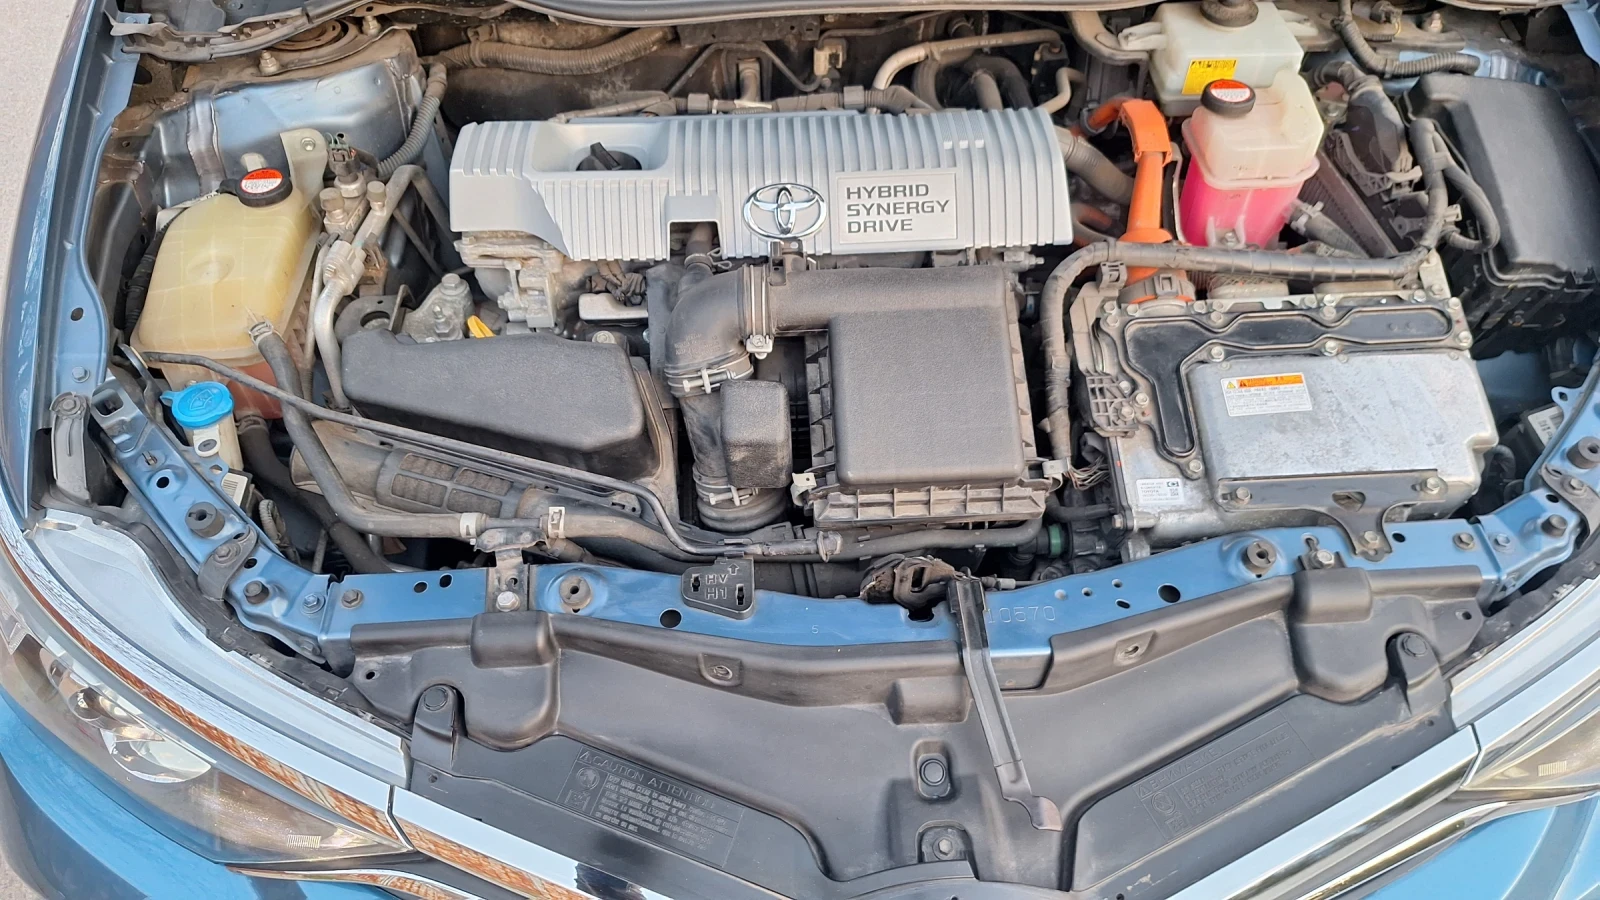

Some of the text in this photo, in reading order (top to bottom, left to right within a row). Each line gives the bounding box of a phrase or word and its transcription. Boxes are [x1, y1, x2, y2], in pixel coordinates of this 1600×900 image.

[846, 184, 929, 200] HYBRID
[847, 199, 950, 217] SYNERGY
[847, 218, 913, 234] DRIVE
[705, 573, 728, 585] HV
[705, 587, 727, 600] H1
[592, 755, 645, 782] CAUTION
